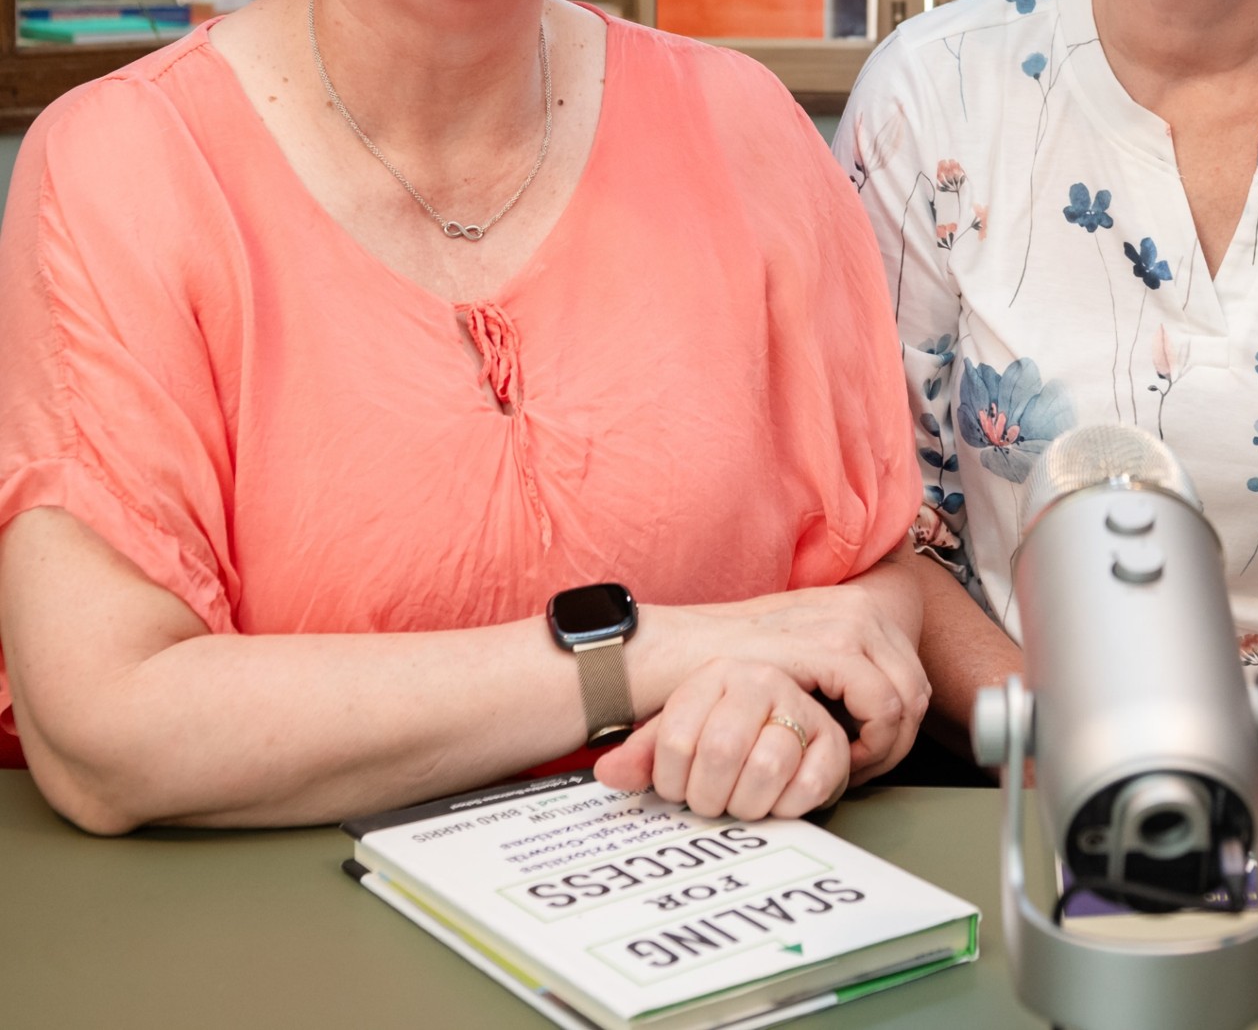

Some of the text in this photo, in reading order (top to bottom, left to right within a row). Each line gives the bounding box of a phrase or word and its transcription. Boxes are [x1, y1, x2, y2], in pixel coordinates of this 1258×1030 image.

[411, 821, 475, 843] HARRIS
[476, 808, 521, 825] BRAD
[499, 807, 644, 851] Organizations
[528, 798, 603, 824] BARTLOW
[504, 813, 671, 864] for High-Growth
[519, 822, 688, 874] People Priorities
[526, 826, 768, 909] SUCCESS
[643, 874, 750, 913] FOR
[625, 878, 866, 969] SCALING
